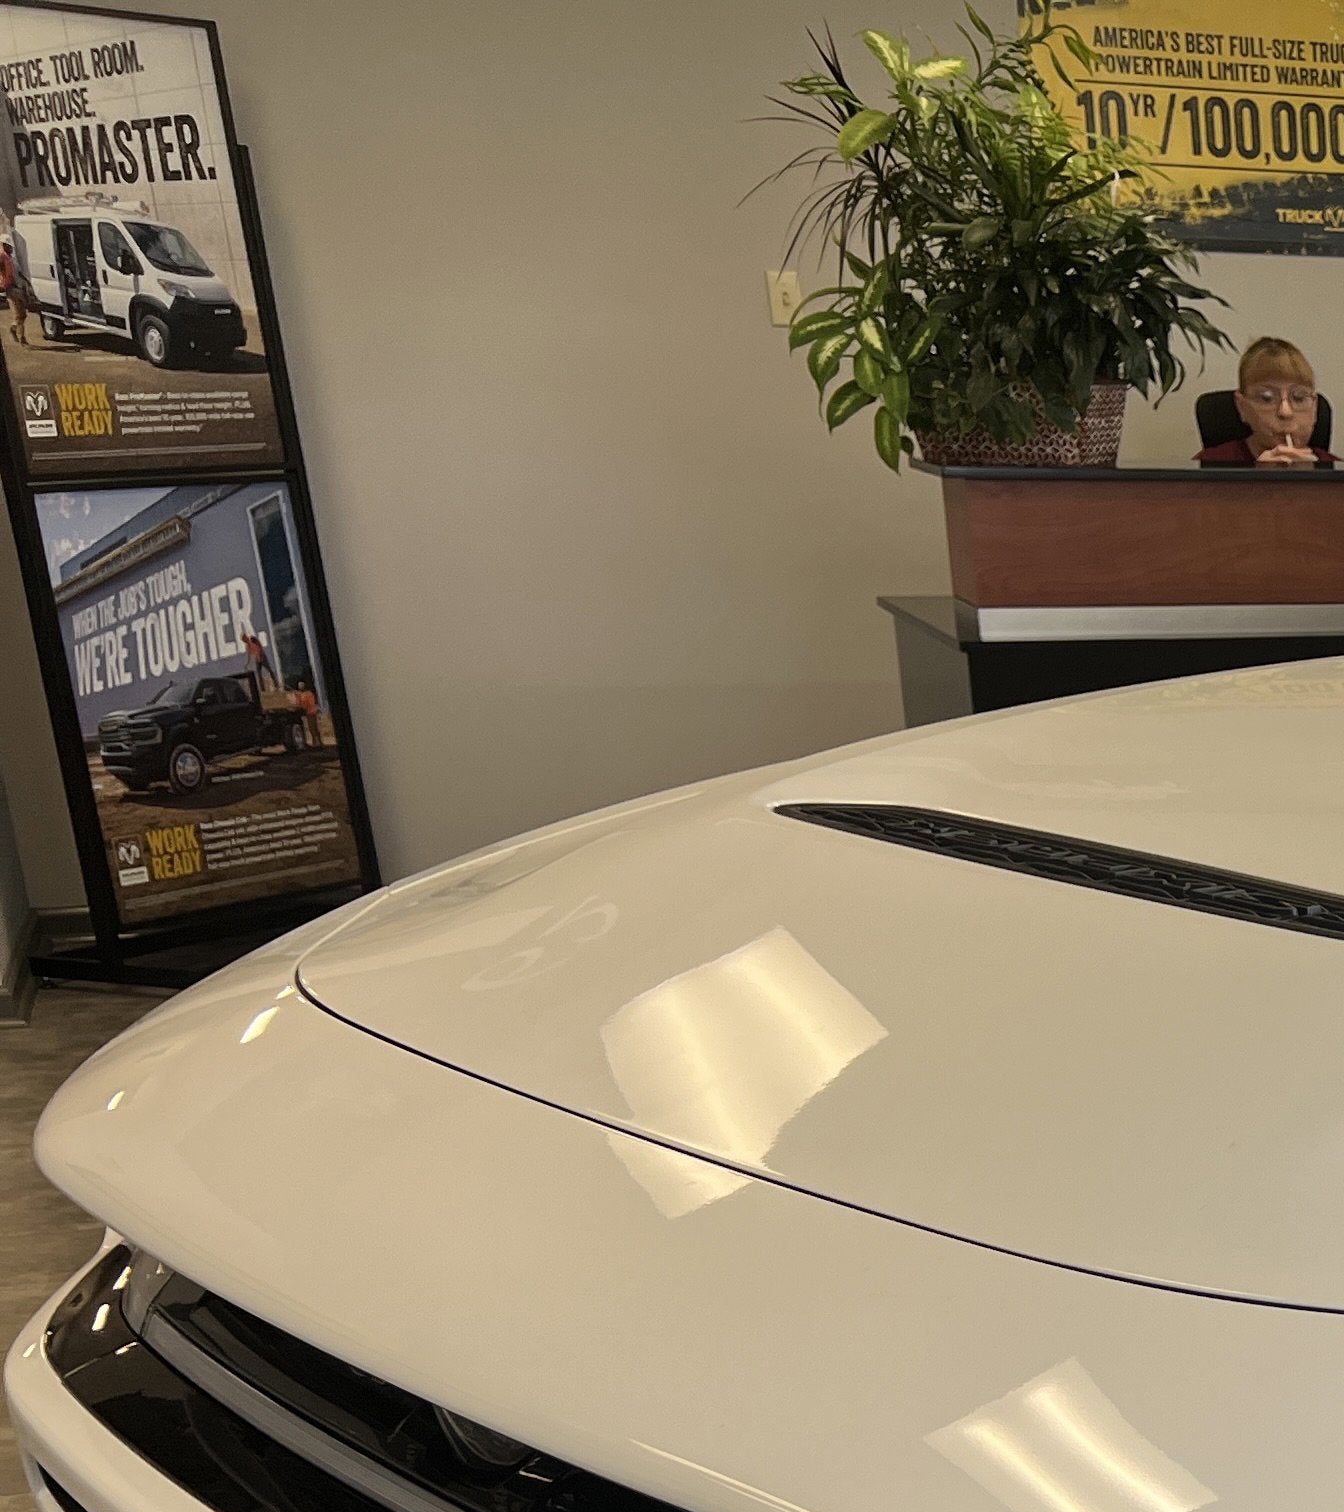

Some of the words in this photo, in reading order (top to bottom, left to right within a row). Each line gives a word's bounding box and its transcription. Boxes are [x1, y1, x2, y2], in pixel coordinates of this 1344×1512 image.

[1093, 25, 1180, 52] AMERICA'S
[1185, 32, 1224, 55] BEST
[1229, 35, 1306, 61] FULL-SIZE
[0, 58, 50, 92] OFFICE.
[49, 50, 90, 85] TOOL
[90, 40, 145, 79] ROOM.
[1094, 53, 1203, 79] POWERTRAIN
[1207, 61, 1270, 84] LIMITED
[5, 87, 96, 127] WAREHOUSE.
[13, 114, 217, 188] PROMASTER.
[1275, 208, 1324, 224] TRUCK
[54, 383, 111, 411] WORK
[61, 410, 114, 438] READY
[72, 606, 98, 640] WHEN
[97, 595, 117, 628] THE
[117, 580, 147, 621] JOB'S
[146, 560, 192, 607] TOUGH,
[74, 625, 133, 696] WE'RE
[131, 577, 268, 680] TOUGHER.
[146, 824, 199, 855] WORK
[153, 850, 202, 881] READY
